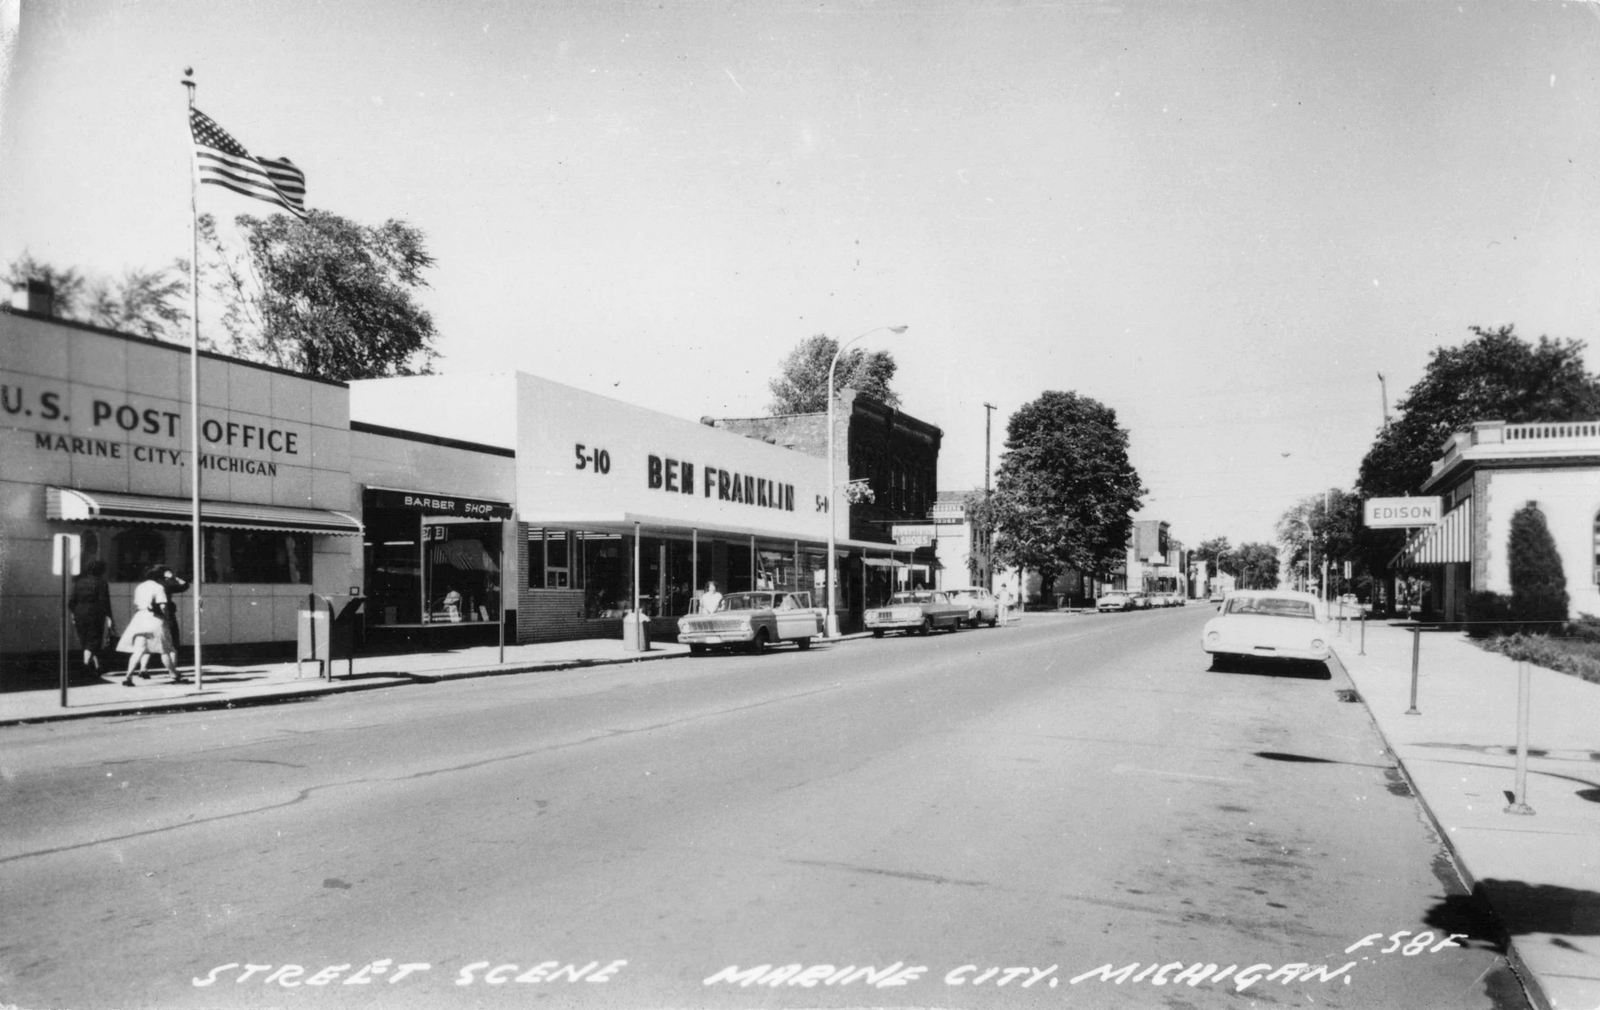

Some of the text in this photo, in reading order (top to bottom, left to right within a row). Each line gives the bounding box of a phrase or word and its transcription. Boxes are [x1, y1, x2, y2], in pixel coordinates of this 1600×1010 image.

[0, 384, 299, 455] U.S. POST OFFICE
[34, 432, 122, 460] MARINE
[198, 454, 278, 478] MICHIGAN
[575, 443, 611, 475] 5-10
[647, 453, 795, 513] BEN FRANKLIN
[404, 496, 494, 514] BARBER SHOP
[815, 494, 830, 514] 5-1
[1373, 506, 1432, 519] EDISON
[900, 535, 928, 545] SHOES
